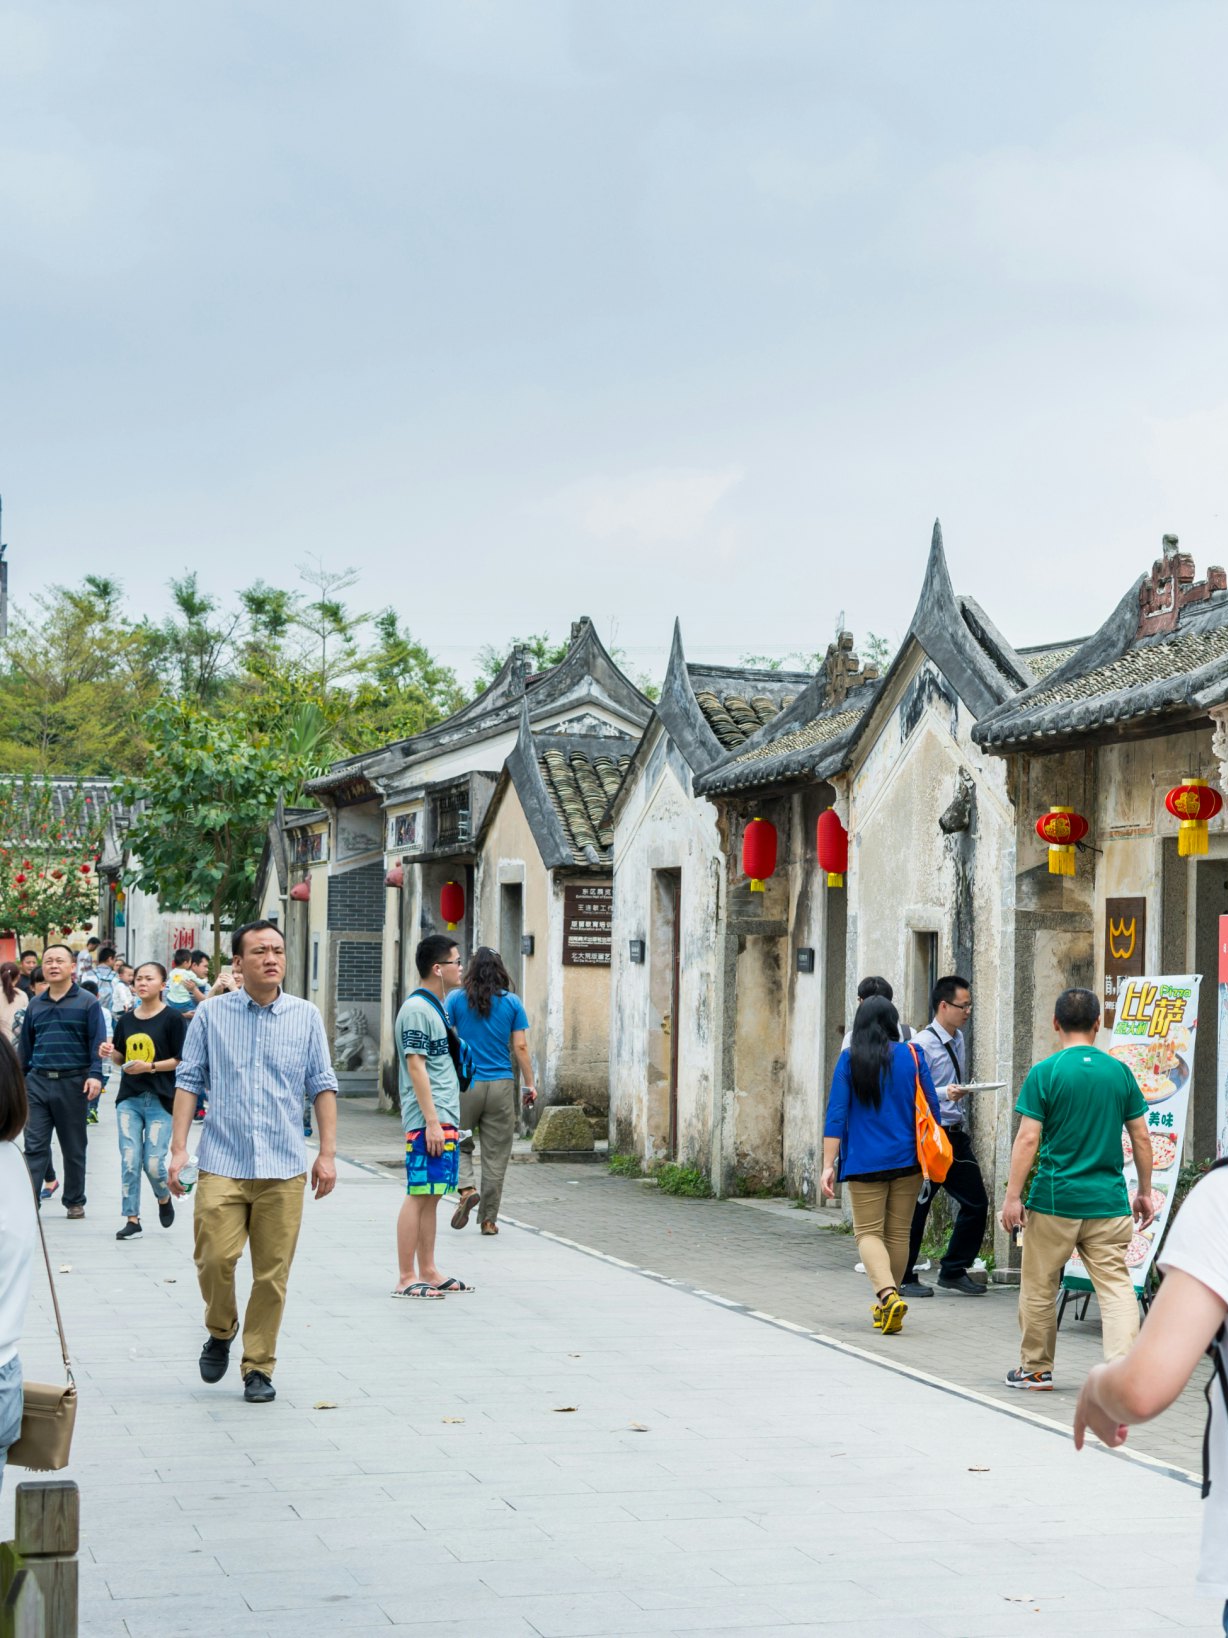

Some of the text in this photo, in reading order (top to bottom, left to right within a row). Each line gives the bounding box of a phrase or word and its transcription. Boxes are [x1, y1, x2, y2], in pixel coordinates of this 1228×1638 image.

[1159, 984, 1192, 998] Pizza
[1121, 981, 1187, 1038] 比萨
[1114, 1021, 1149, 1036] 意大利
[1148, 1111, 1174, 1128] 美味
